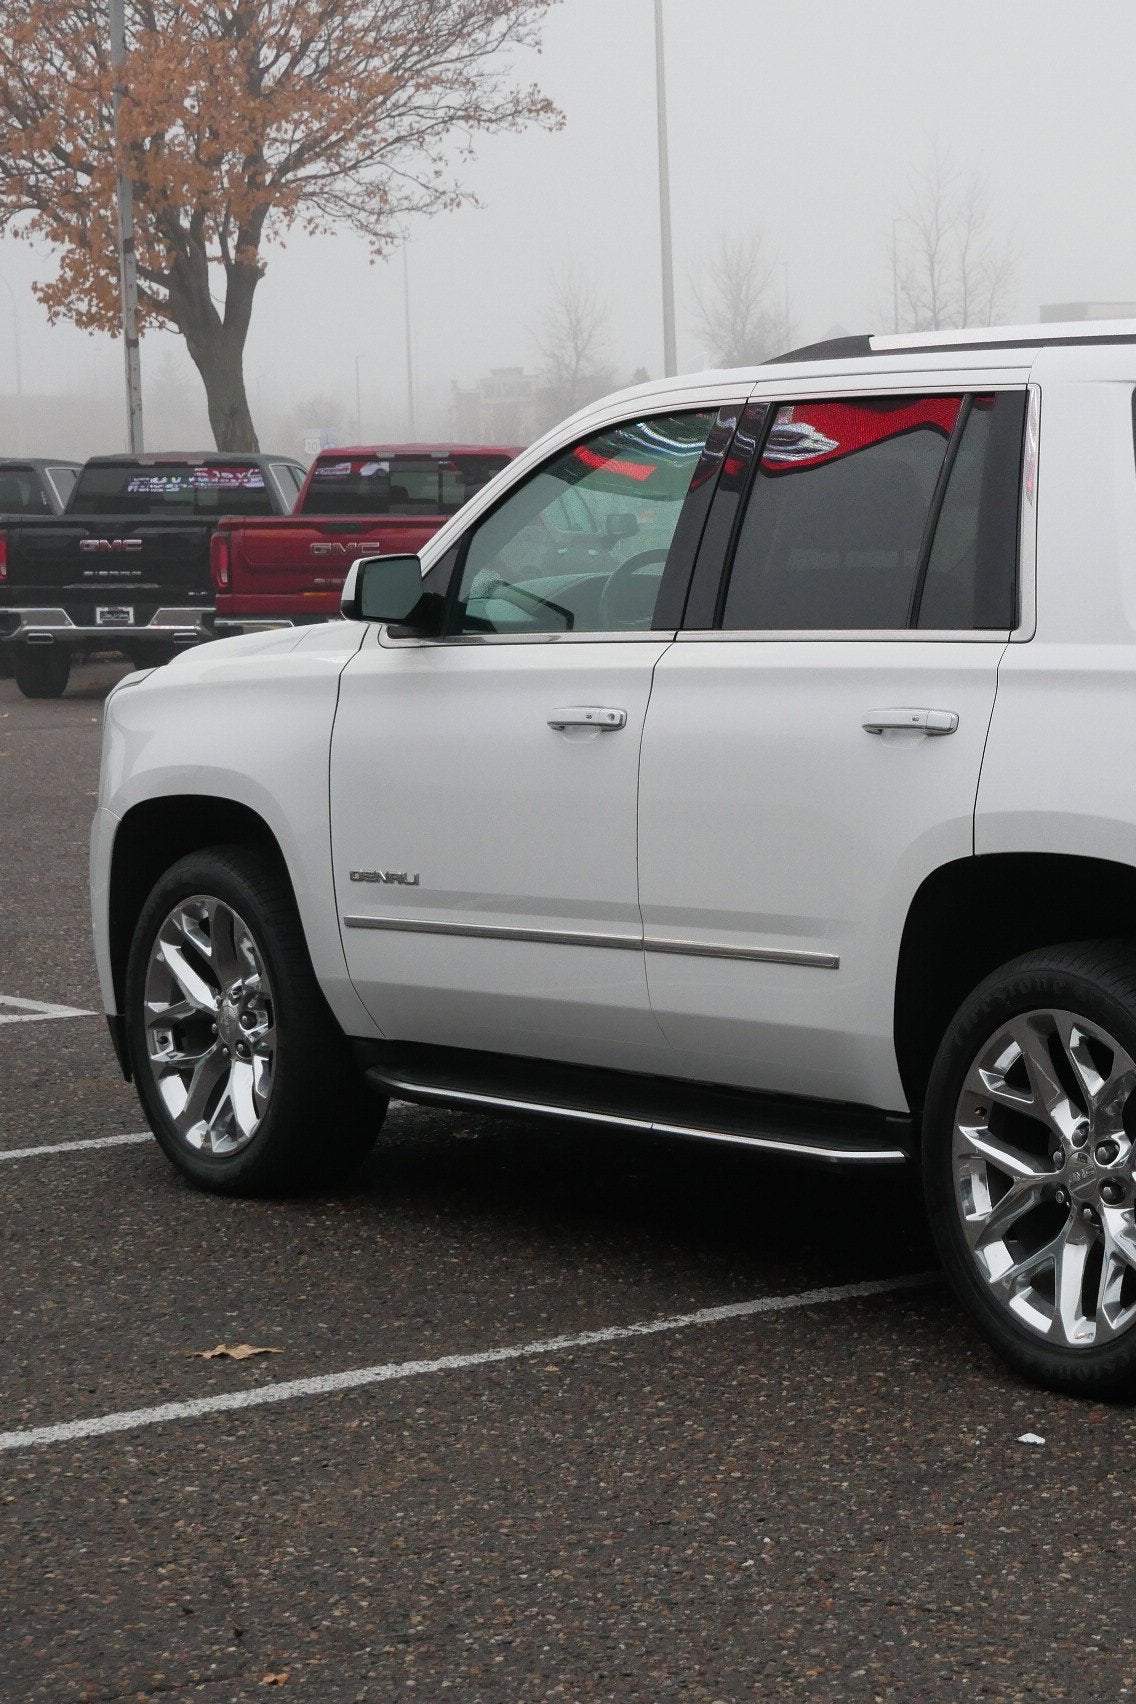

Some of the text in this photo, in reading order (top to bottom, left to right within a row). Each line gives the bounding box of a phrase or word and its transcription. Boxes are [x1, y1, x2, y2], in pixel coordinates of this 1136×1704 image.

[79, 539, 142, 552] GMC
[310, 542, 380, 554] GMC
[349, 870, 420, 886] DENALI
